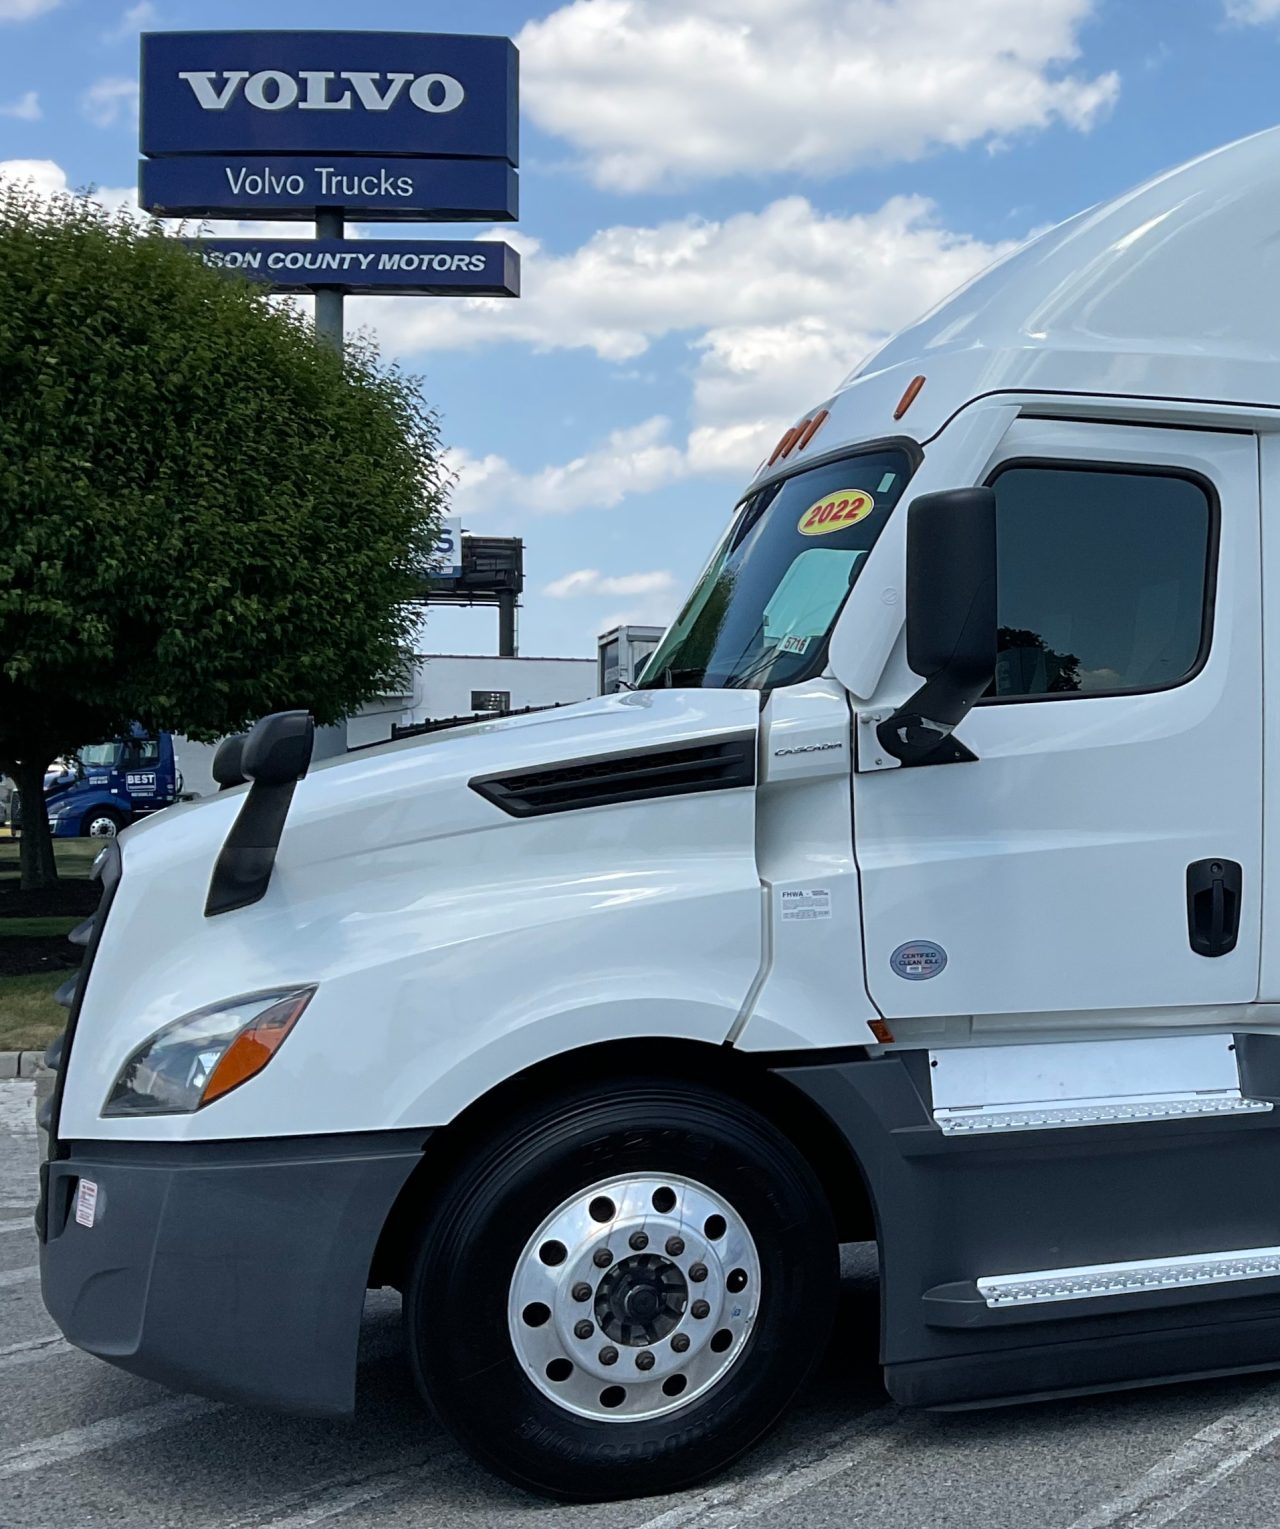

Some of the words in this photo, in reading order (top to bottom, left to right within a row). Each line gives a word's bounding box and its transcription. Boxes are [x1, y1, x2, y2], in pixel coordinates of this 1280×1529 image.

[178, 70, 465, 114] VOLVO
[225, 167, 304, 195] Volvo
[314, 167, 414, 197] Trucks
[266, 252, 376, 270] COUNTY
[377, 253, 487, 272] MOTORS
[803, 497, 865, 528] 2022
[783, 636, 807, 653] 5716
[127, 774, 155, 784] BEST
[782, 890, 804, 898] FHWA
